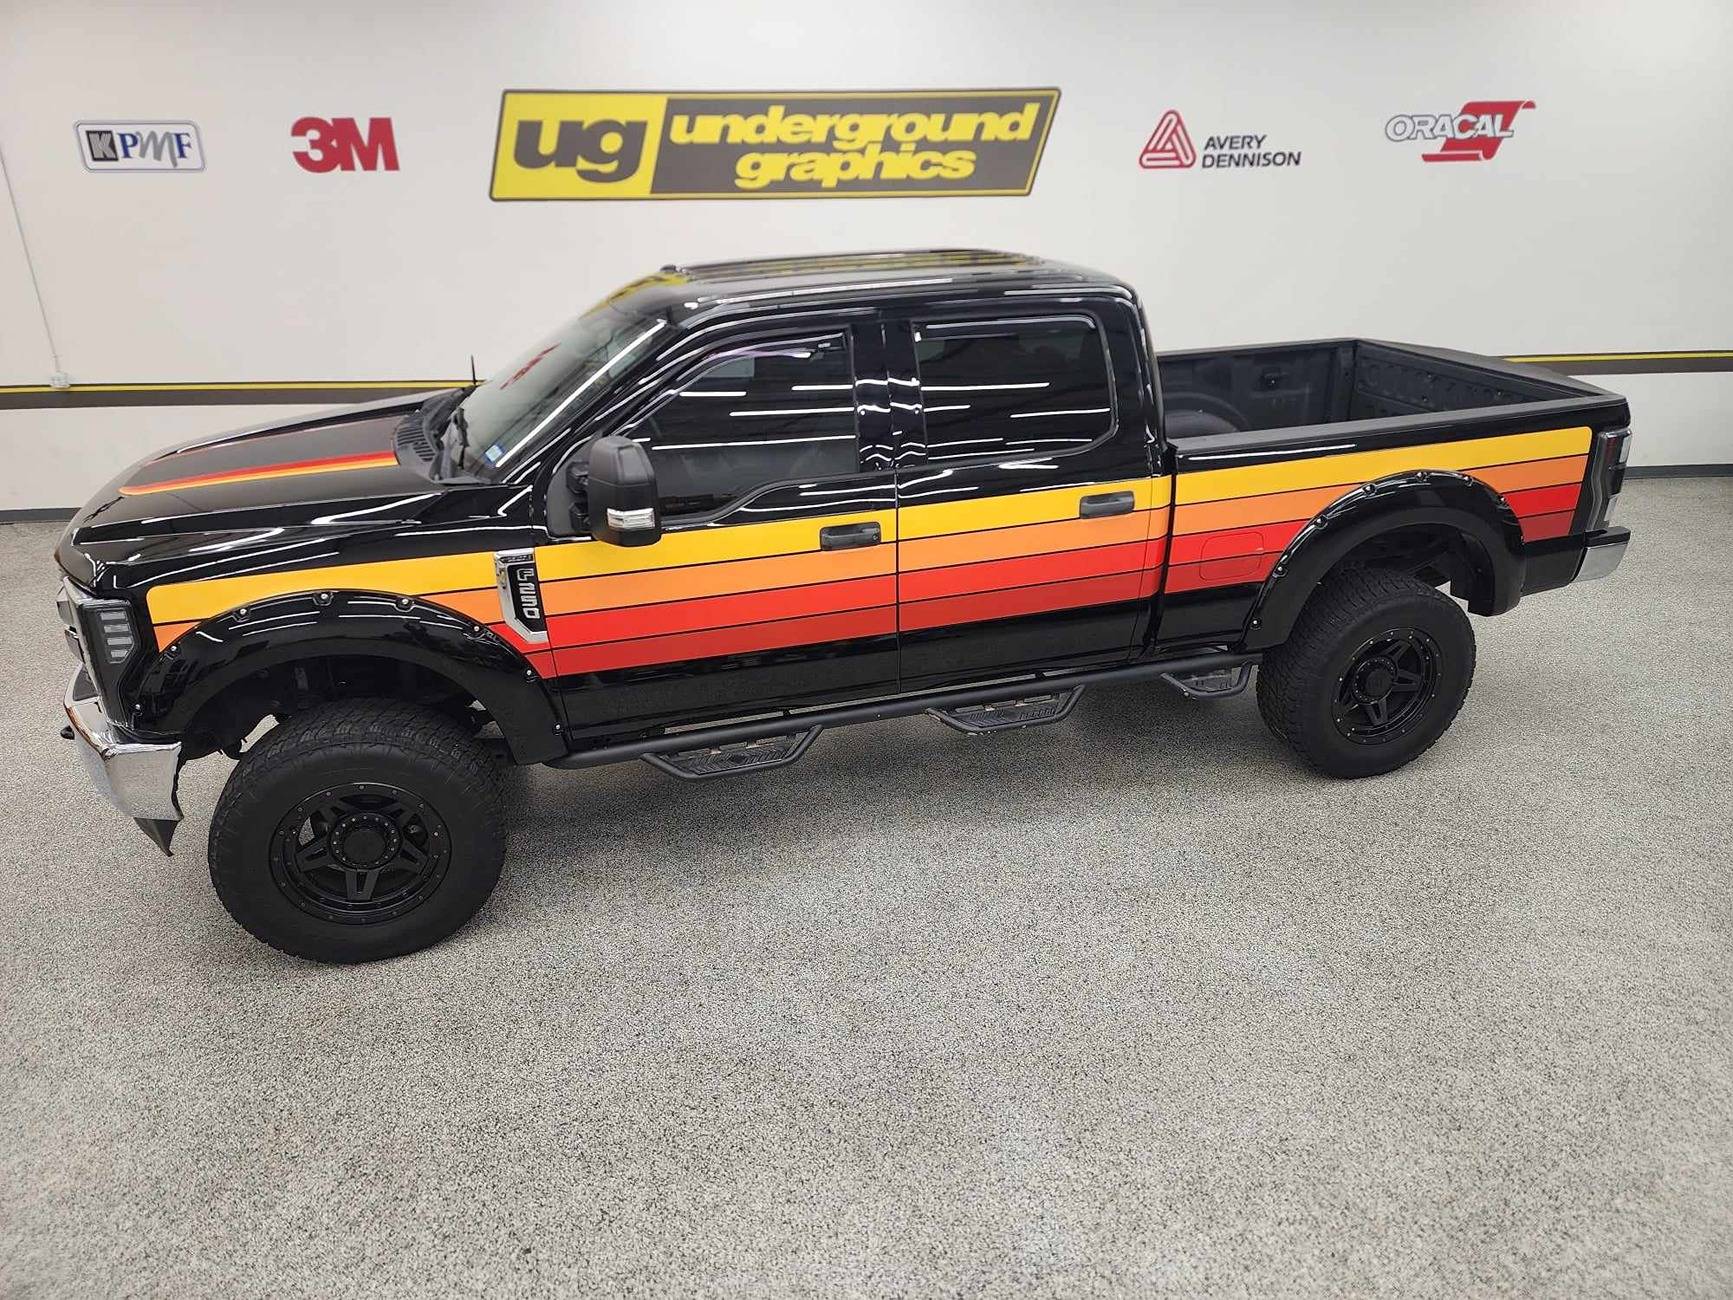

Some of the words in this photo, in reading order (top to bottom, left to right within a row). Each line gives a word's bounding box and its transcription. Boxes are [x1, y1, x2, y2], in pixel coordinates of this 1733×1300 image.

[291, 116, 400, 173] 3M
[669, 103, 1041, 148] underground
[1204, 134, 1268, 152] AVERY
[1385, 113, 1515, 142] ORACAL
[85, 130, 193, 168] KPMF
[513, 119, 648, 183] ug
[735, 143, 976, 188] graphics
[1202, 151, 1302, 169] DENNISON
